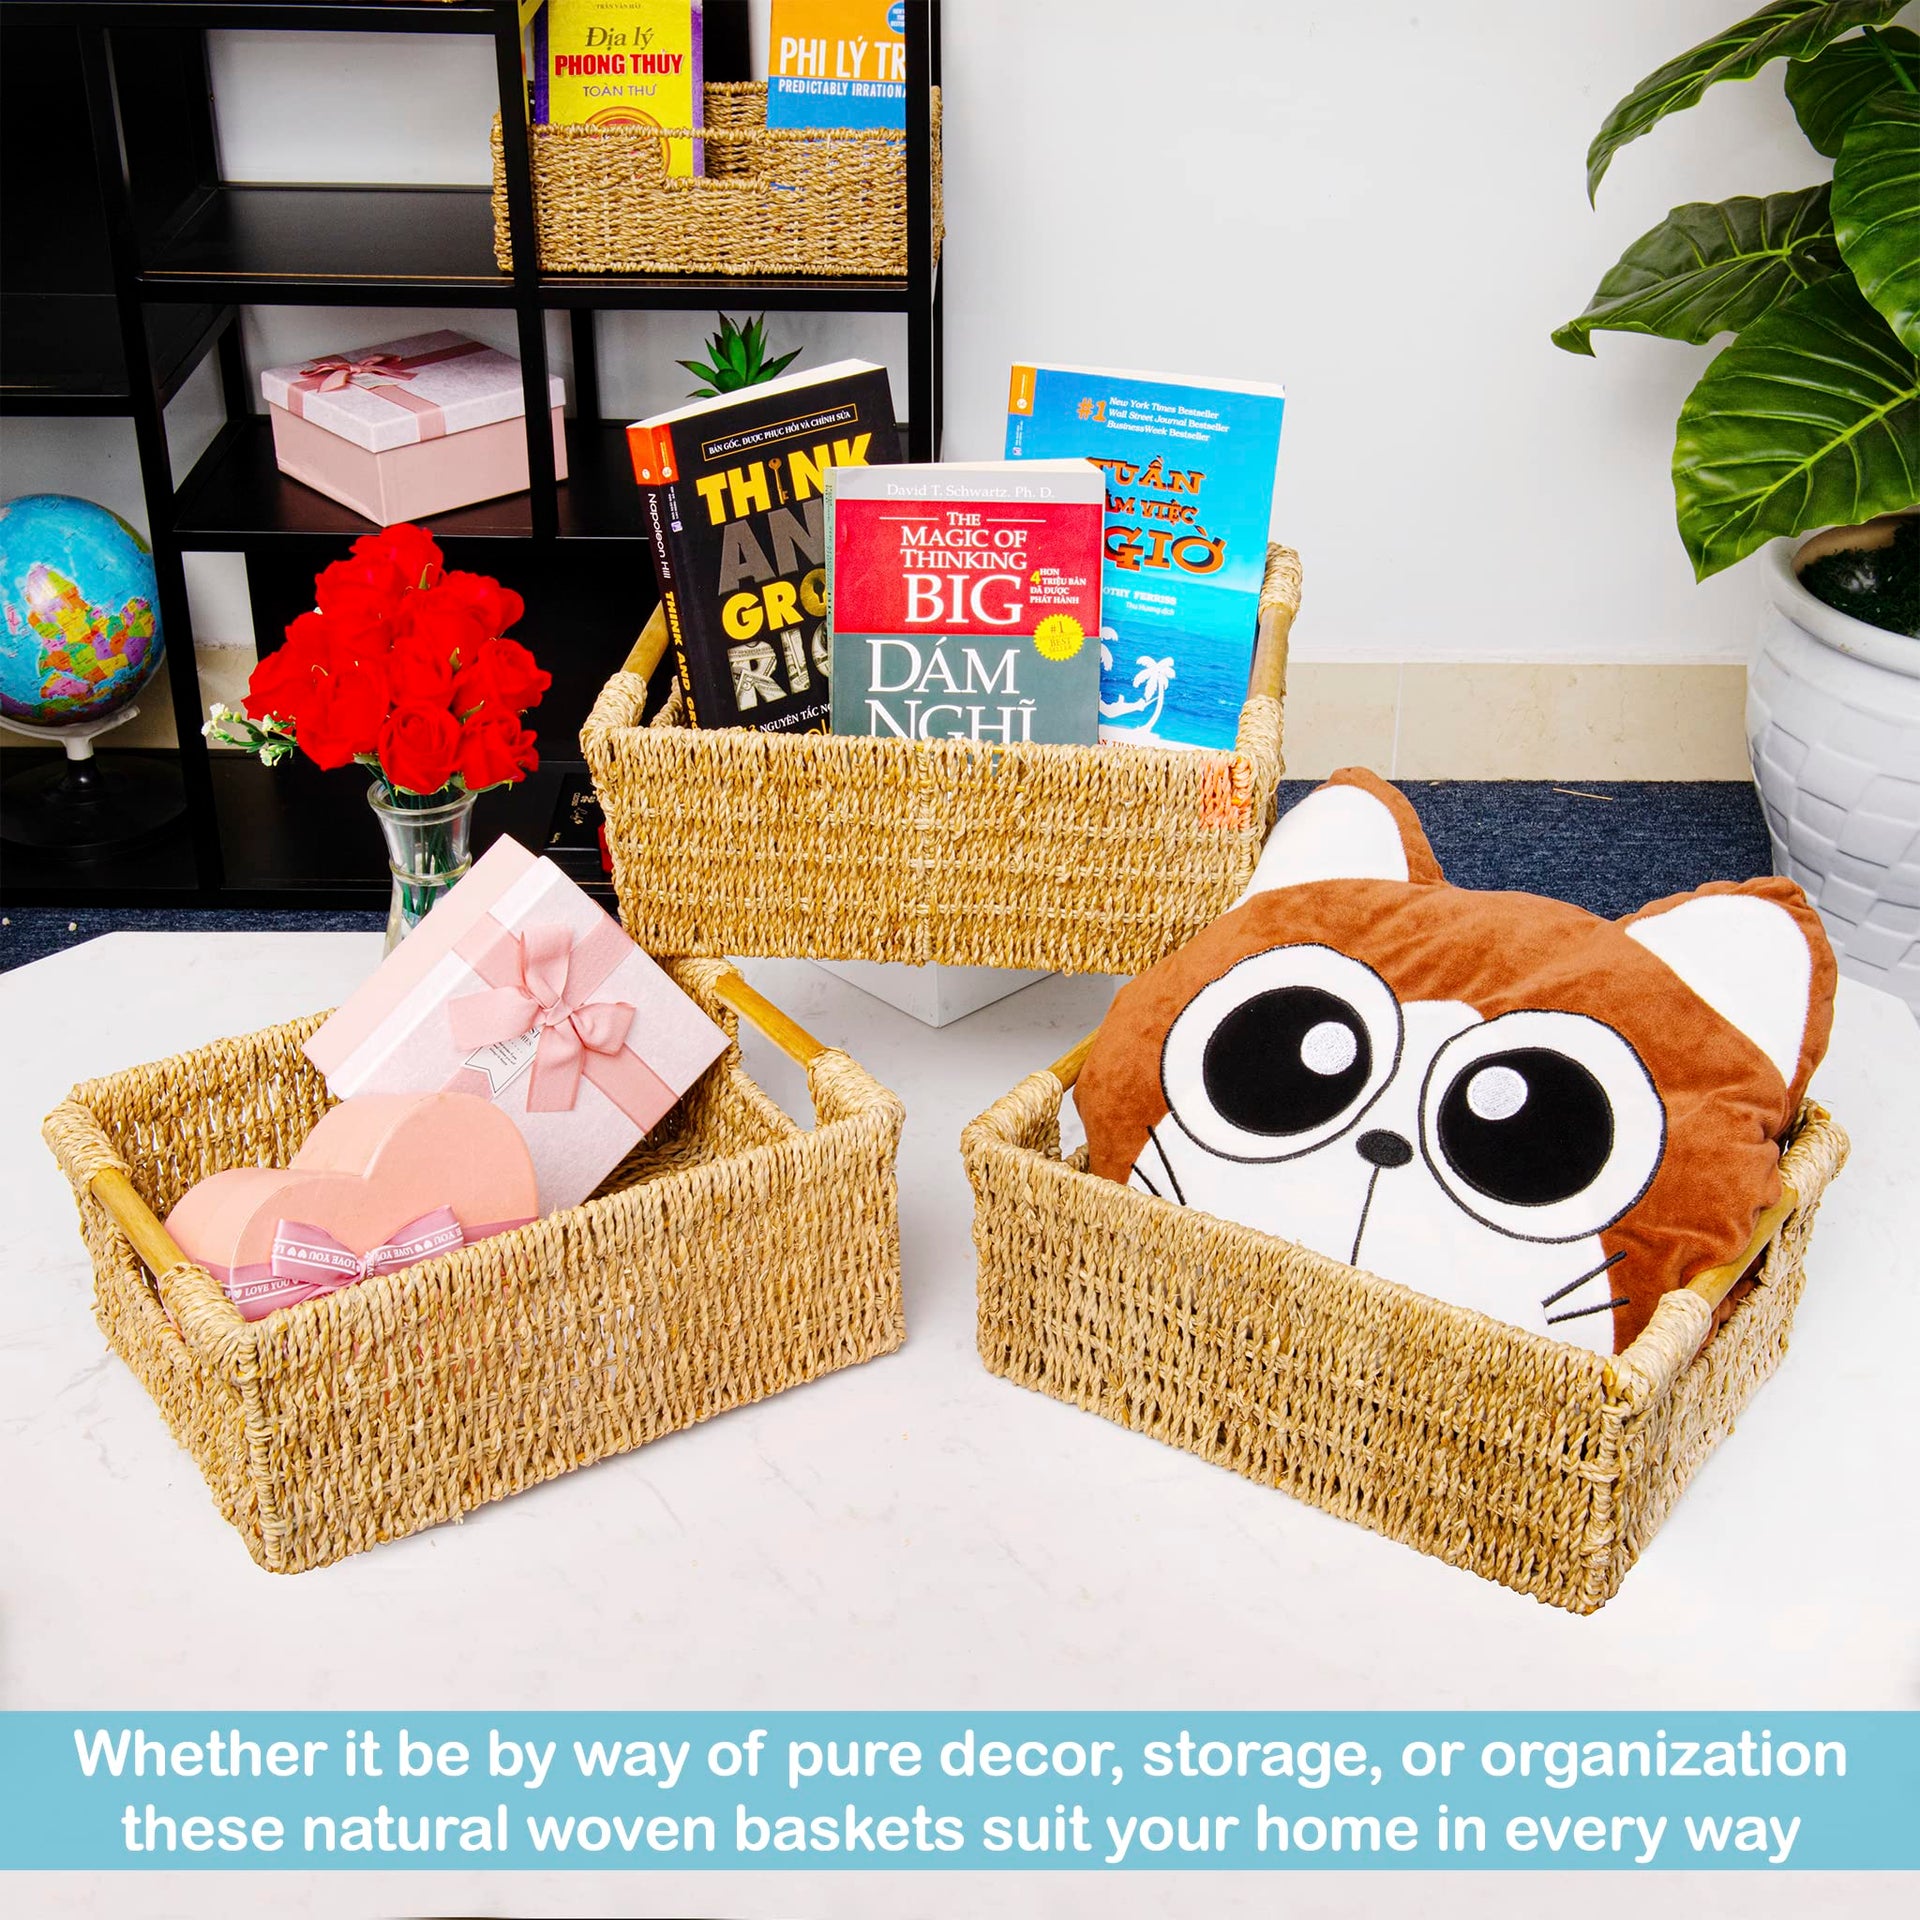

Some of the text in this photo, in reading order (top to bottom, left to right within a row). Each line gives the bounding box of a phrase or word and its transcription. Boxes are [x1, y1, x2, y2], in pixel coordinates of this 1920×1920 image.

[585, 26, 655, 50] Địa lý
[554, 48, 684, 76] PHONG THỦY
[780, 35, 906, 81] PHI LÝ TR
[583, 82, 657, 97] TOÀN THƯ
[778, 79, 906, 98] PREDICTABLY IRRATION
[1076, 397, 1107, 423] #1
[1109, 397, 1220, 420] New York Times Bestseller
[1108, 408, 1230, 433] Wall Street Journal Bestseller
[708, 442, 723, 455] BẢN
[764, 428, 784, 440] PHỤC
[800, 419, 811, 430] VÀ
[1169, 428, 1211, 442] Bestseller
[886, 484, 927, 496] David
[930, 485, 943, 496] T.
[1015, 486, 1036, 498] Ph.
[1040, 487, 1055, 498] D.
[946, 512, 981, 526] THE
[1140, 498, 1198, 526] VIỆC
[648, 493, 671, 579] Napoleon Hill
[718, 499, 826, 596] AN
[900, 526, 1028, 548] MAGIC OF
[900, 548, 1028, 570] THINKING
[1104, 524, 1226, 575] GIỜ
[1030, 570, 1041, 585] 4
[1042, 577, 1067, 586] TRIỆU
[902, 573, 1023, 625] BIG
[1029, 595, 1080, 605] PHÁT HÀNH
[1044, 586, 1070, 595] ĐƯỢC
[1103, 586, 1130, 598] OTHY
[722, 568, 827, 640] GRO
[665, 591, 698, 730] THINK AND GRO
[866, 636, 1021, 695] DÁM
[760, 714, 798, 733] NGUYÊN
[800, 705, 819, 720] TẮC
[864, 698, 1037, 745] NGHĨ
[434, 1231, 456, 1245] YOU
[309, 1250, 330, 1261] YOU
[331, 1254, 357, 1269] LOVE
[394, 1247, 414, 1257] LOVE
[245, 1278, 290, 1297] LOVE YOU
